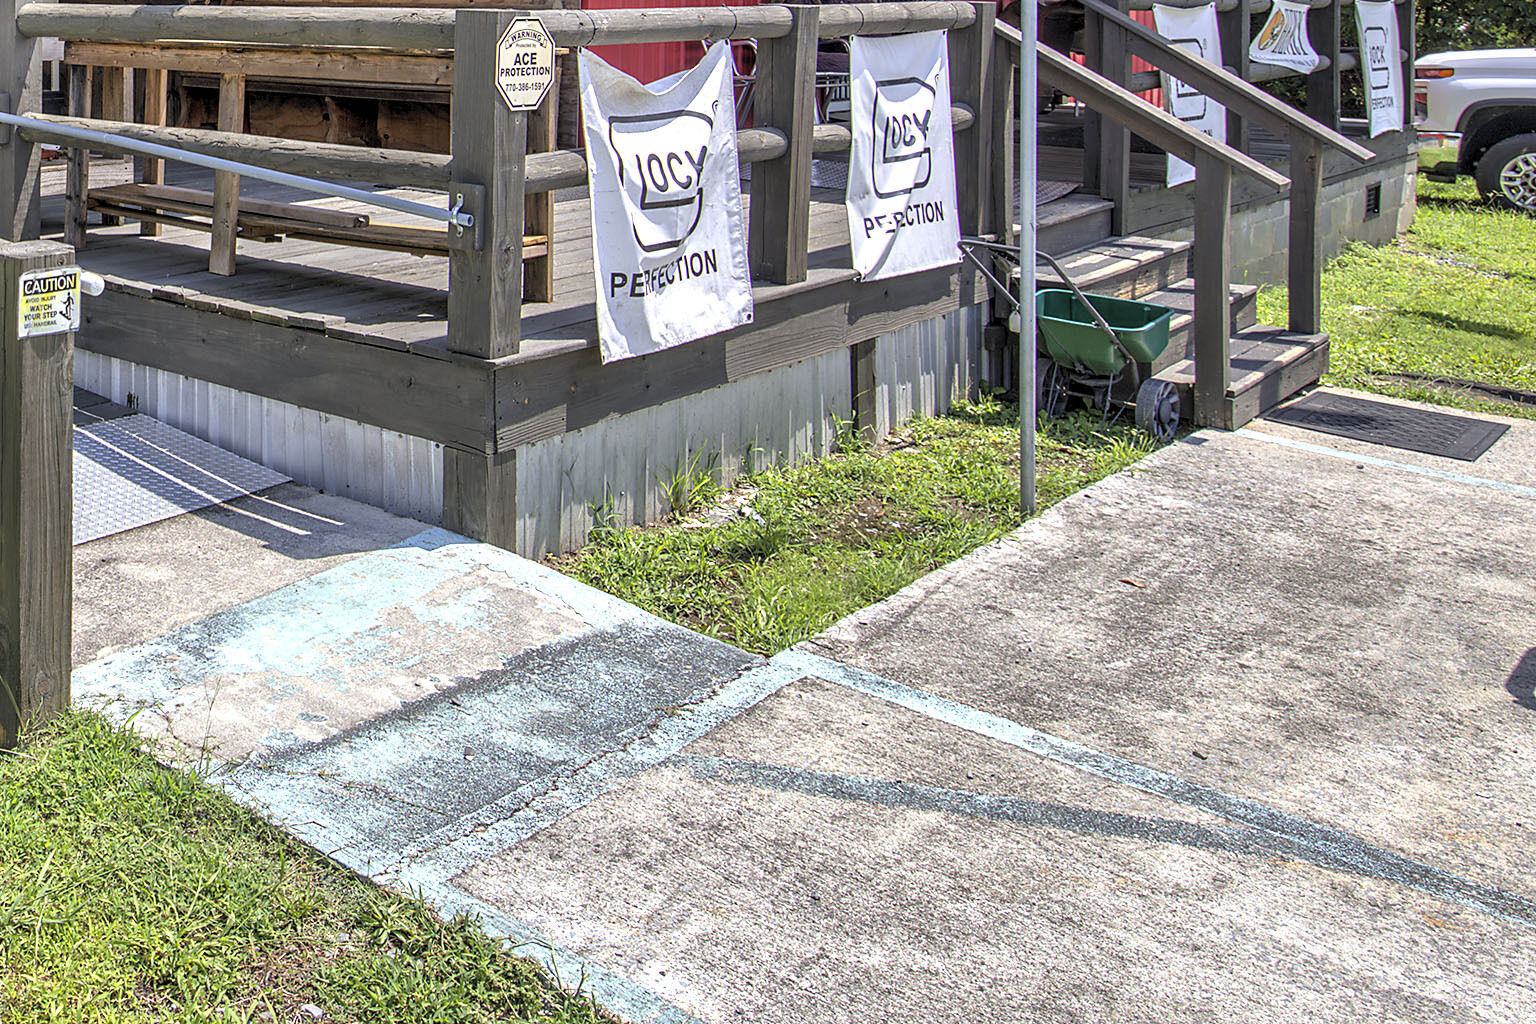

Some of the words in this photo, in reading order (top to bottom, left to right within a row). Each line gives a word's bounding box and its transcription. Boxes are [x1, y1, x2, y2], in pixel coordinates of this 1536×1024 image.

[510, 31, 542, 42] WARNING
[513, 52, 538, 66] ACE
[500, 66, 551, 77] PROTECTION
[505, 82, 545, 92] 770-386-1591
[610, 248, 718, 298] PERFECTION
[25, 275, 76, 295] CAUTION
[30, 303, 53, 312] WATCH
[24, 313, 41, 321] YOUR
[42, 310, 57, 319] STEP
